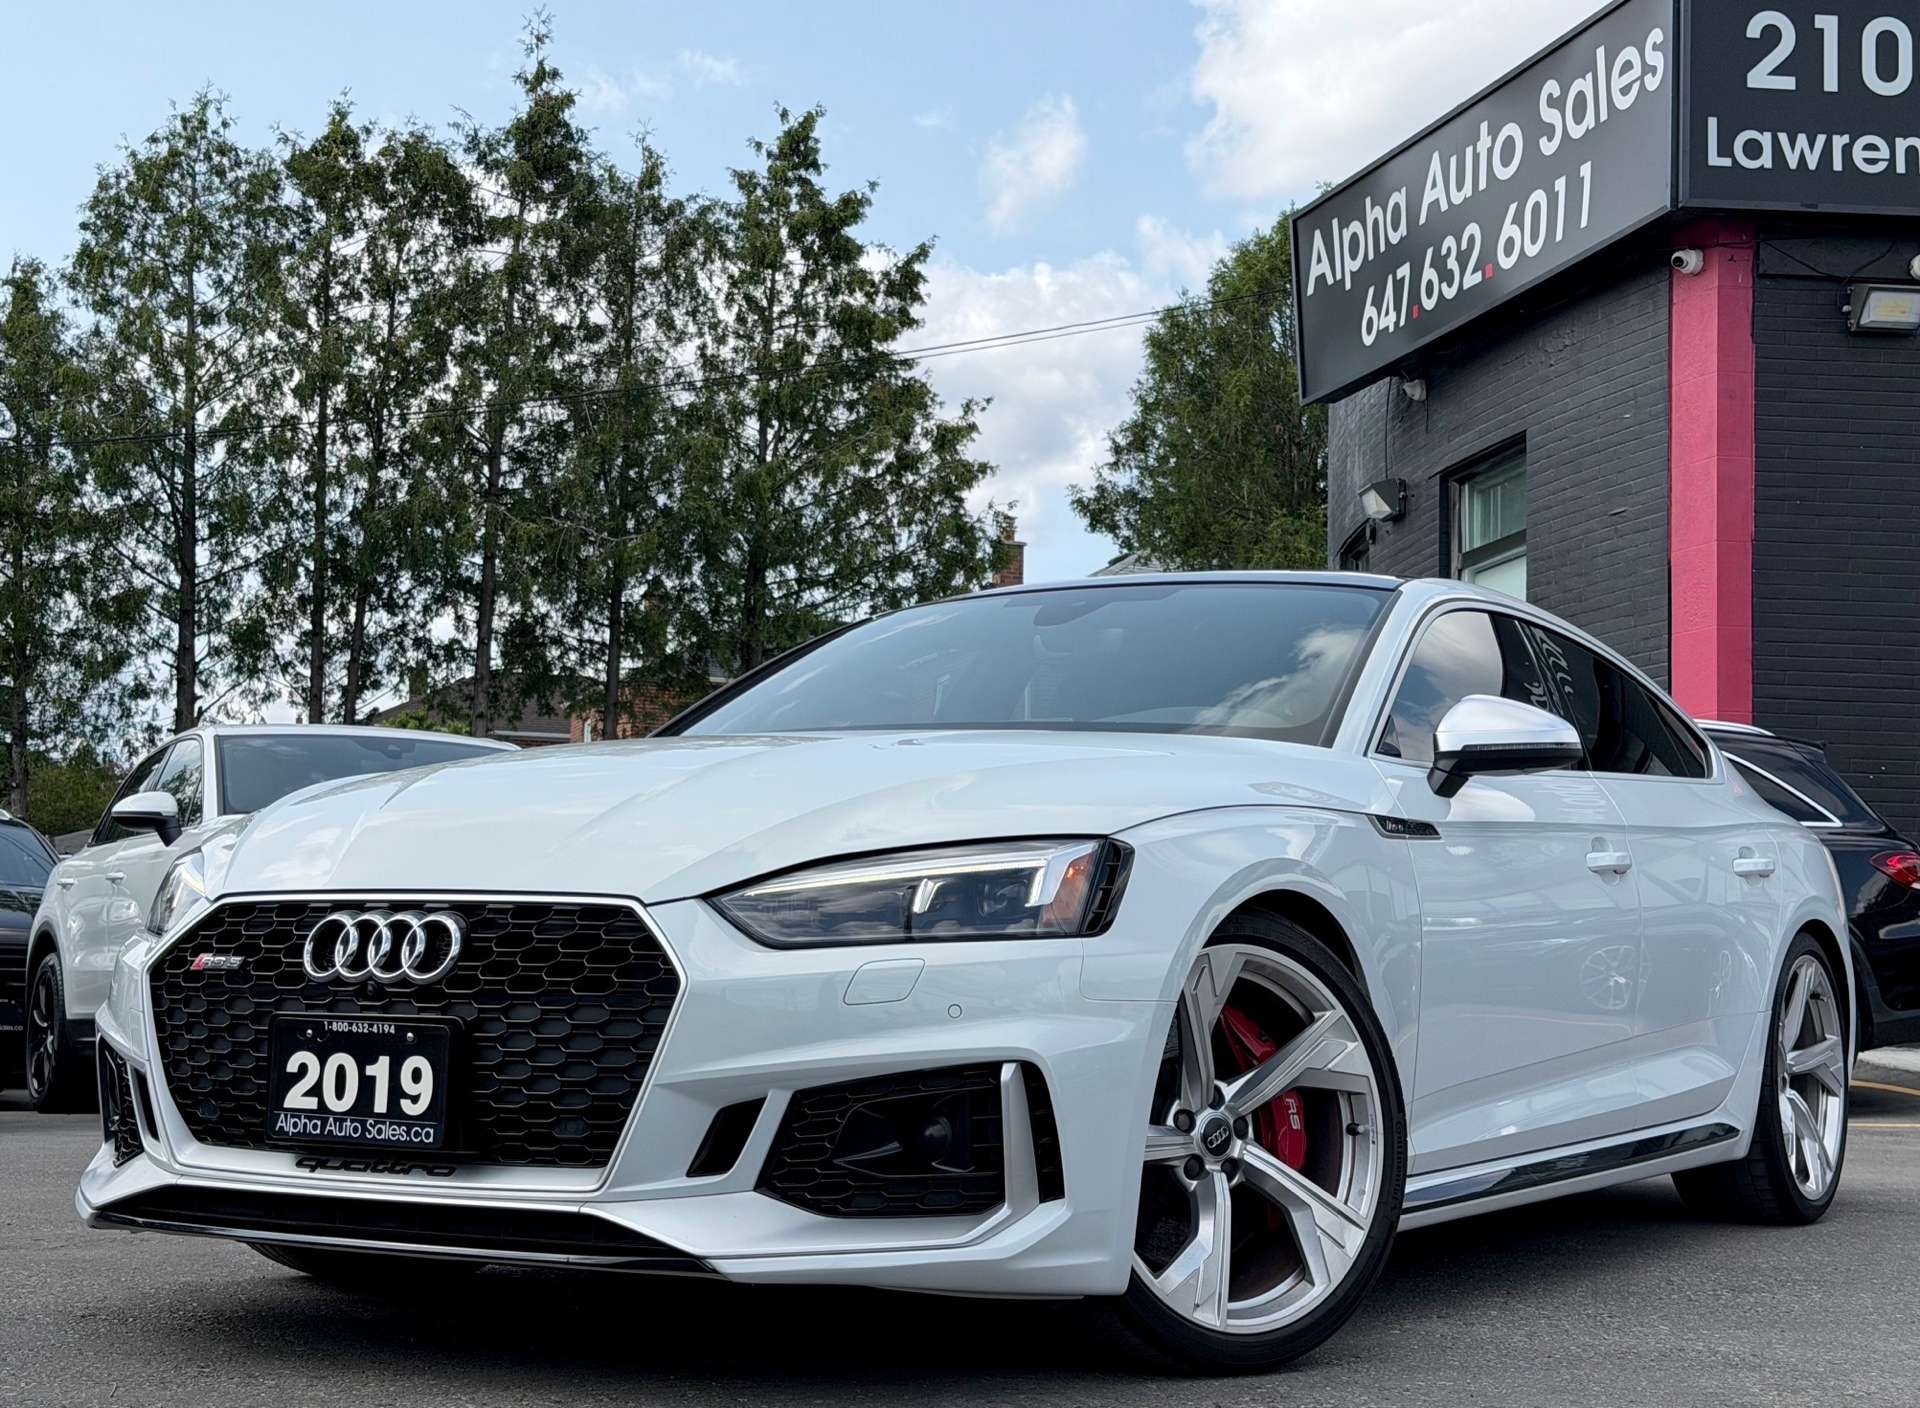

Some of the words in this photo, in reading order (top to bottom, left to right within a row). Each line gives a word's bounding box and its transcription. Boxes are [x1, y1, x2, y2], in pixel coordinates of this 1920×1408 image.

[1306, 186, 1408, 297] Alpha
[1419, 120, 1524, 227] Auto
[1538, 27, 1665, 156] Sales
[1707, 116, 1920, 175] Lawren
[1361, 160, 1592, 347] 647.632.6011
[323, 1021, 396, 1035] 1-800-632-4194
[282, 1050, 434, 1117] 2019
[275, 1114, 322, 1137] Alpha
[324, 1116, 362, 1138] Auto
[365, 1119, 435, 1144] Sales.ca
[1285, 1097, 1301, 1131] RS
[295, 1156, 457, 1178] quattro
